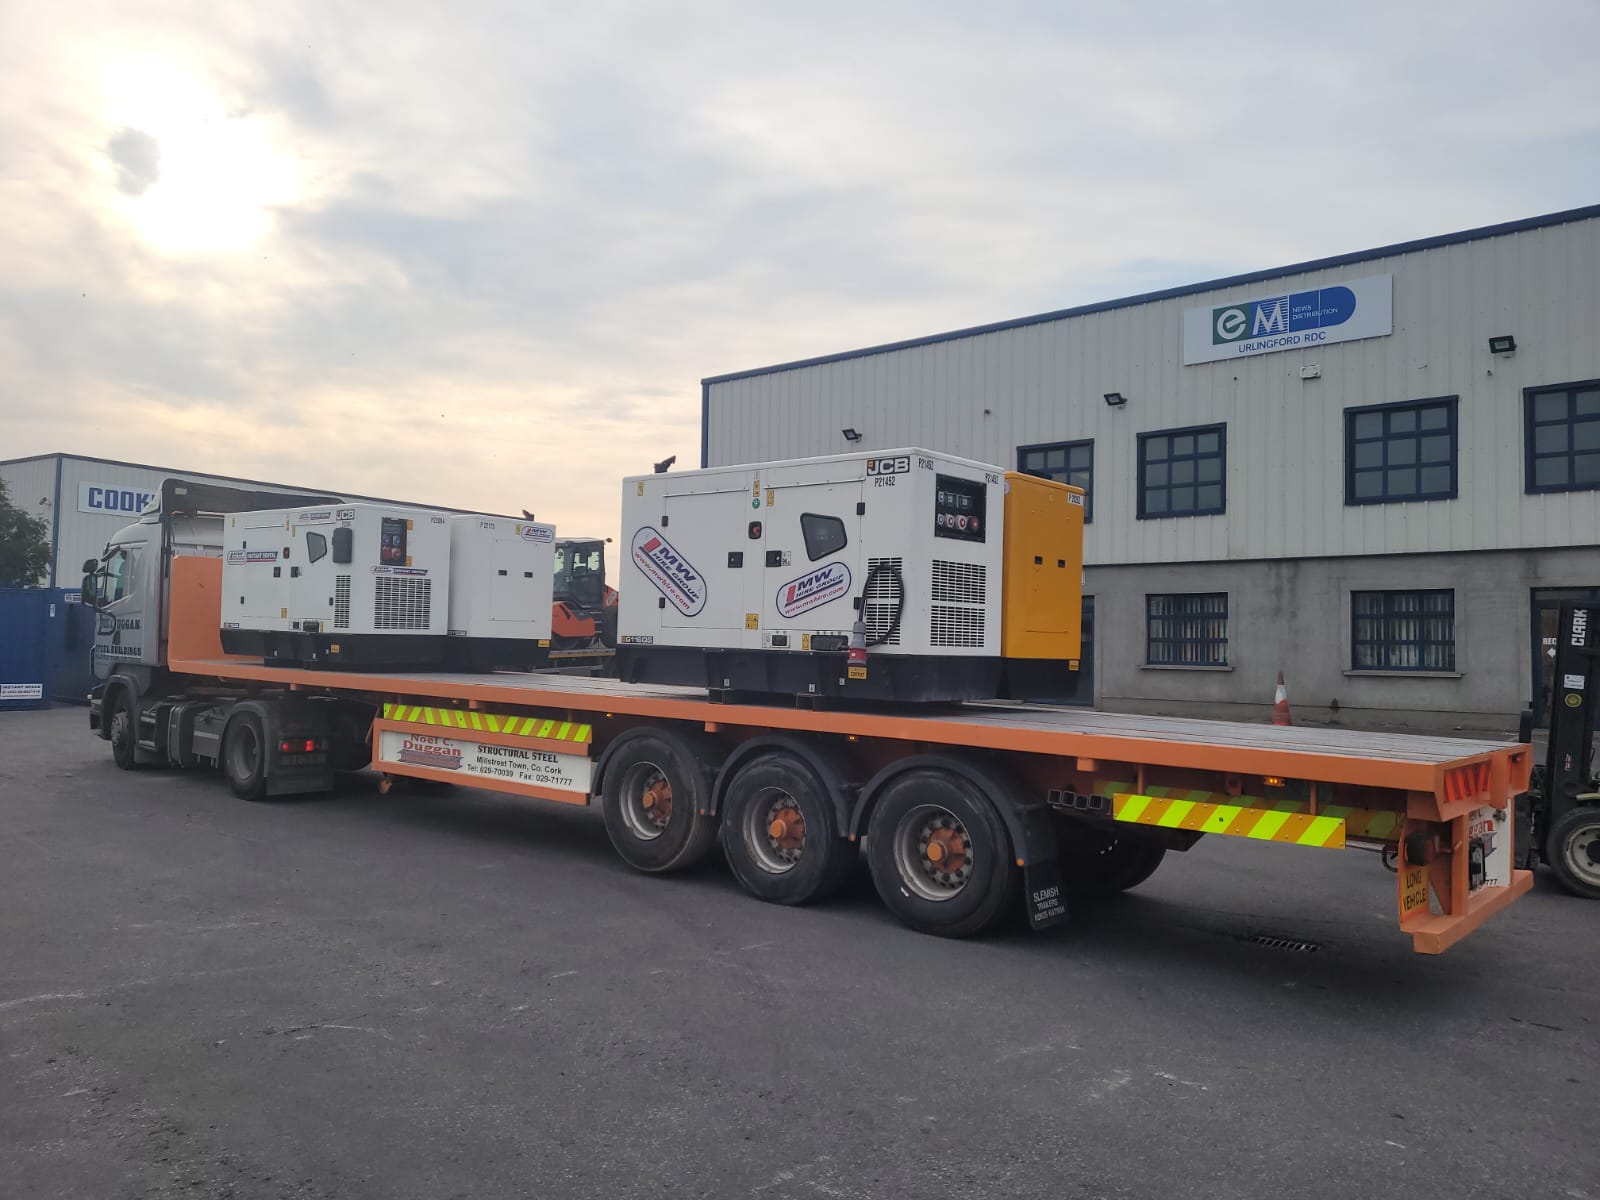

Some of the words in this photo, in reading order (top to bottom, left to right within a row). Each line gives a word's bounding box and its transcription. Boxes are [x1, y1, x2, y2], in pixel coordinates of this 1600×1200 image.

[1292, 305, 1311, 313] NEWS
[1292, 307, 1338, 320] DISTRIBUTION
[1238, 335, 1300, 353] URLINGFORD
[1304, 331, 1326, 342] RDC
[867, 456, 910, 476] JCB
[919, 458, 934, 470] P21452
[874, 476, 895, 487] P21452
[88, 487, 156, 513] COOK
[336, 509, 355, 520] JCB
[659, 547, 697, 582] MW
[634, 552, 690, 609] www.mwhire.com
[652, 553, 672, 571] HIRE
[672, 572, 699, 599] GROUP
[798, 568, 833, 591] MW
[796, 586, 813, 598] HIRE
[816, 574, 843, 589] GROUP
[785, 586, 844, 615] www.mwhire.com
[1571, 609, 1587, 646] CLARK
[1543, 637, 1557, 645] REC
[403, 740, 461, 756] Duggan
[411, 733, 438, 745] Noel
[477, 745, 529, 759] STRUCTURAL
[532, 752, 558, 763] STEEL
[467, 764, 479, 772] Tel:
[480, 767, 514, 778] 029-70039
[519, 771, 534, 780] Fax:
[536, 774, 573, 786] 029-71777
[476, 756, 507, 767] Millstreet
[509, 760, 529, 772] Town,
[531, 763, 543, 772] Co.
[545, 765, 562, 775] Cork
[1406, 870, 1422, 888] LONG
[1033, 886, 1059, 903] SLEMISH
[1402, 888, 1426, 912] VEHICLE
